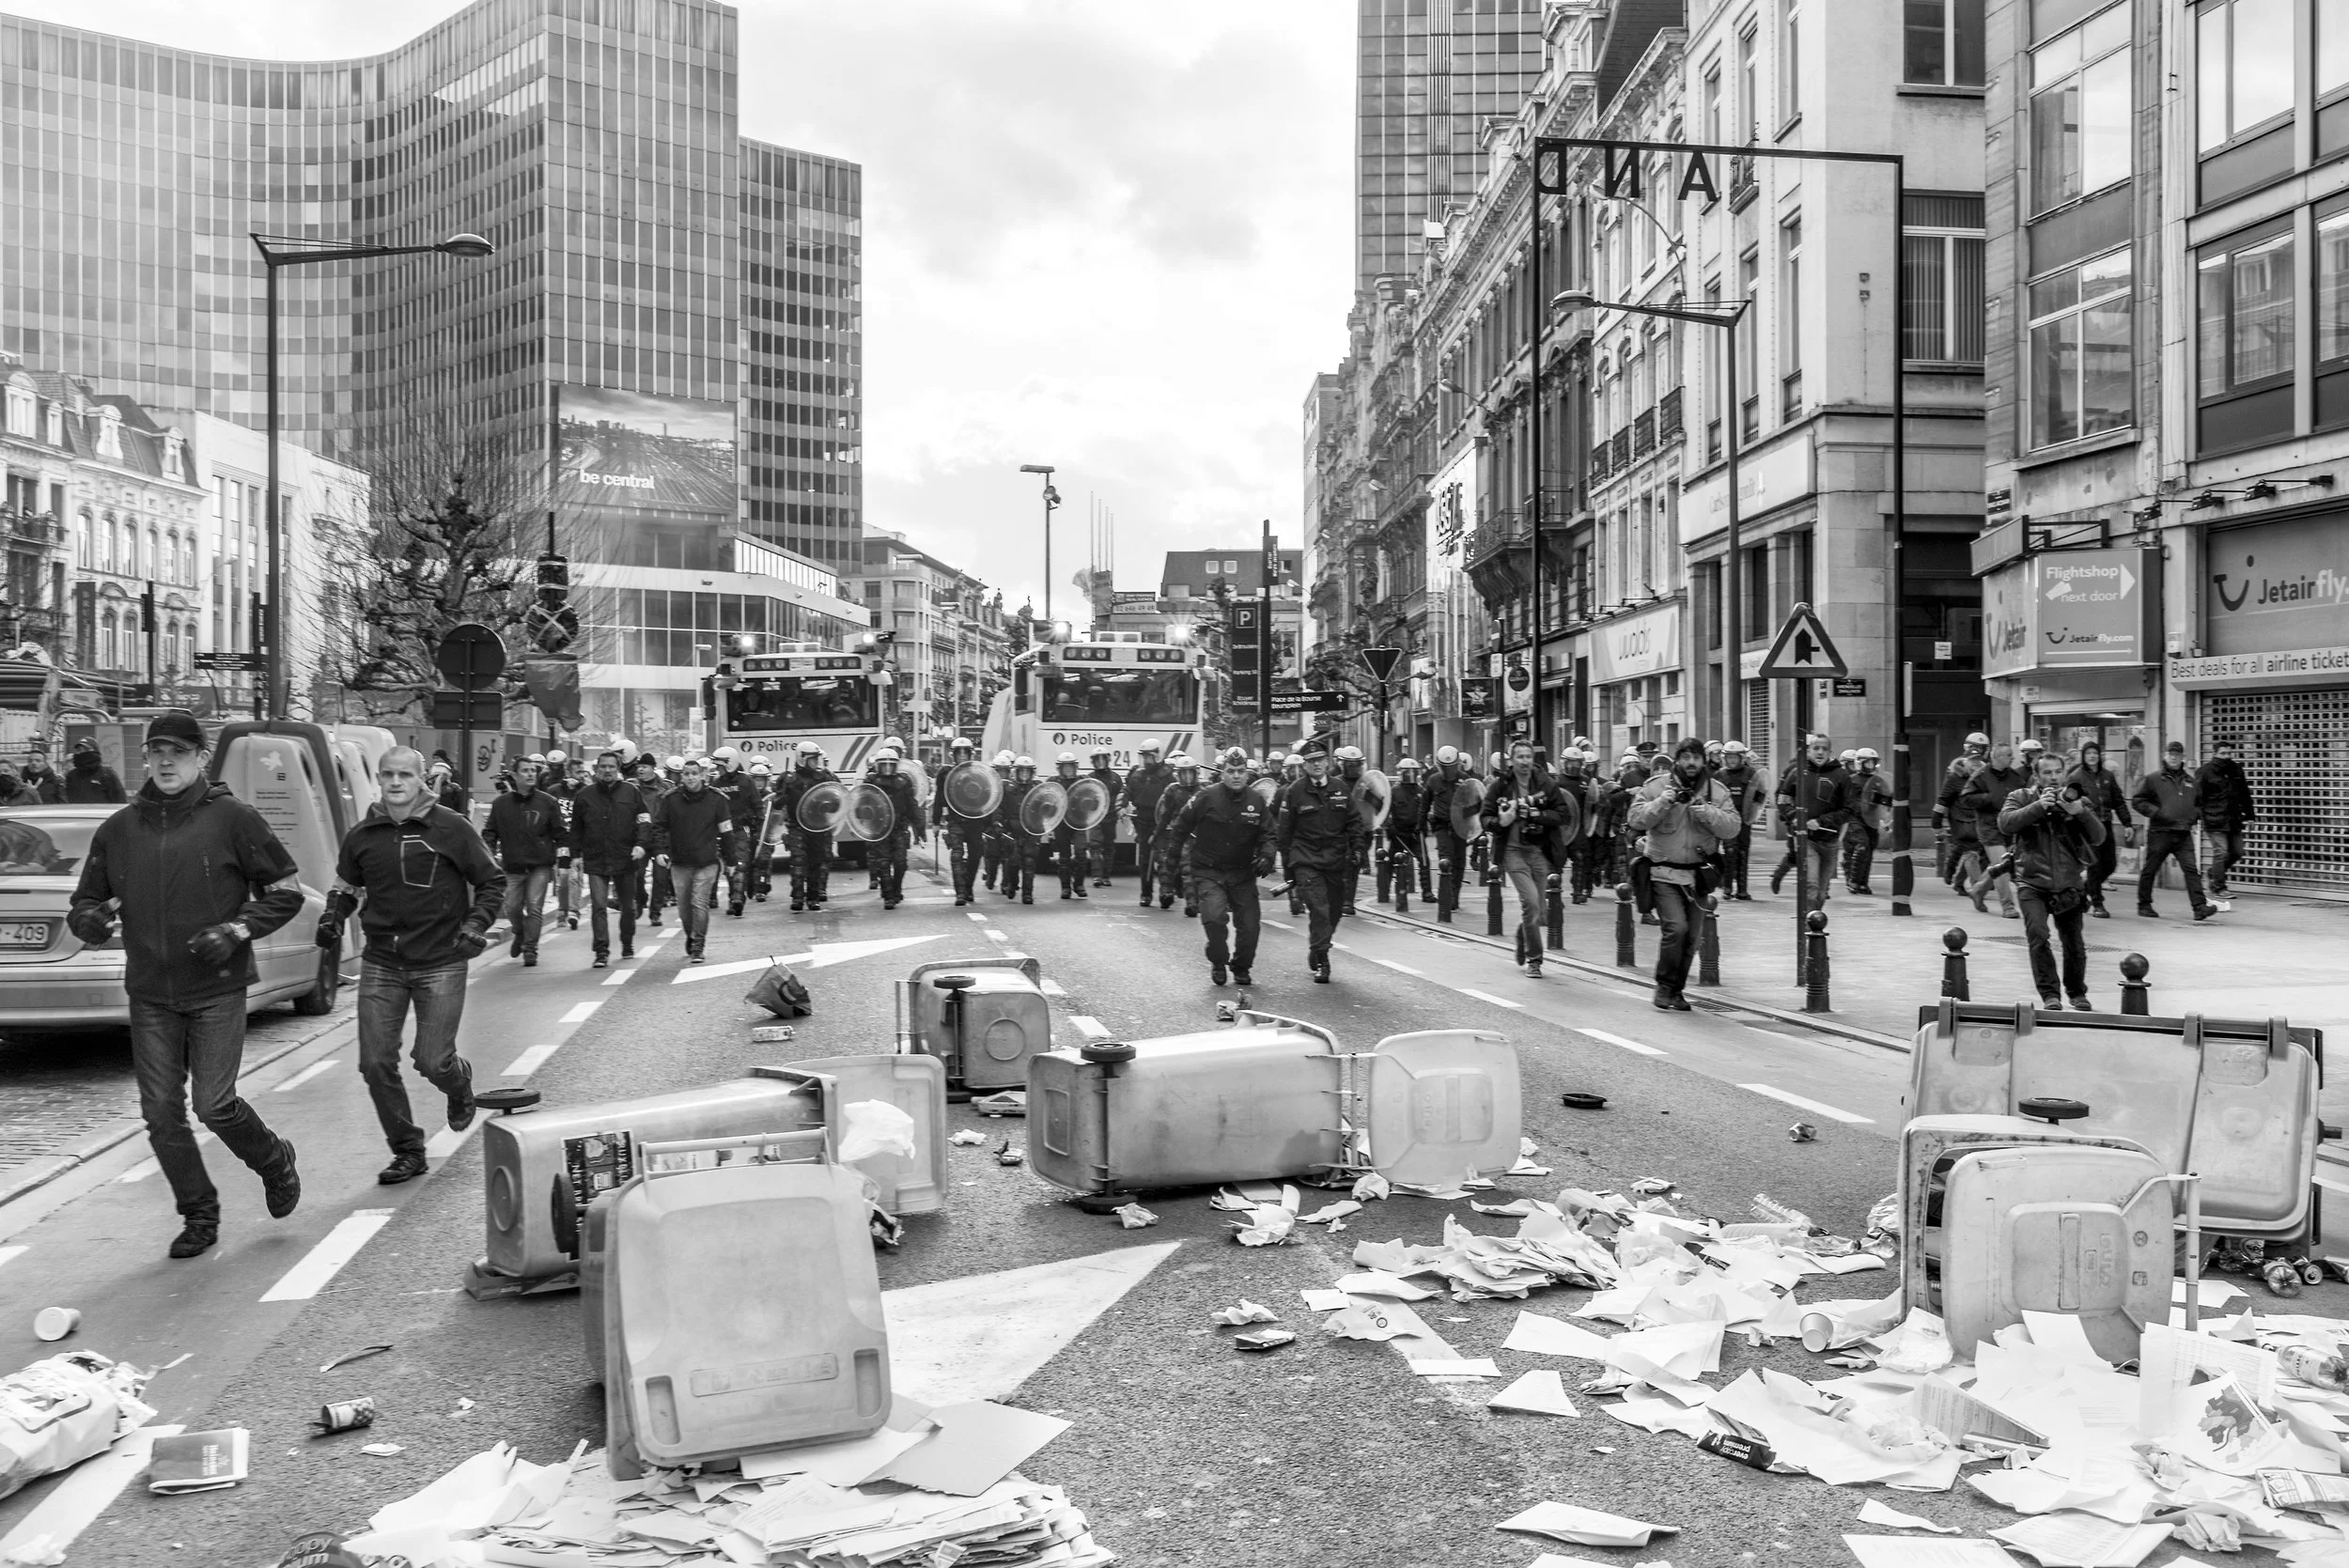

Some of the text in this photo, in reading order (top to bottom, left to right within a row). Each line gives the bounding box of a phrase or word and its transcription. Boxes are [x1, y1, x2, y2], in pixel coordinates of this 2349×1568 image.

[580, 470, 655, 489] be central
[2046, 565, 2120, 582] Flightshop
[2061, 590, 2119, 602] next door
[1240, 611, 1252, 626] P
[2069, 633, 2135, 644] Jetairfly.com
[2171, 660, 2196, 678] Best
[2199, 659, 2228, 676] deals
[2231, 657, 2248, 675] for
[2249, 656, 2264, 674] all
[2266, 653, 2308, 672] airline
[757, 740, 798, 752] Police
[1071, 733, 1112, 745] Police
[0, 925, 45, 941] -409
[1720, 1445, 1750, 1460] evercopy
[1722, 1439, 1751, 1452] premium
